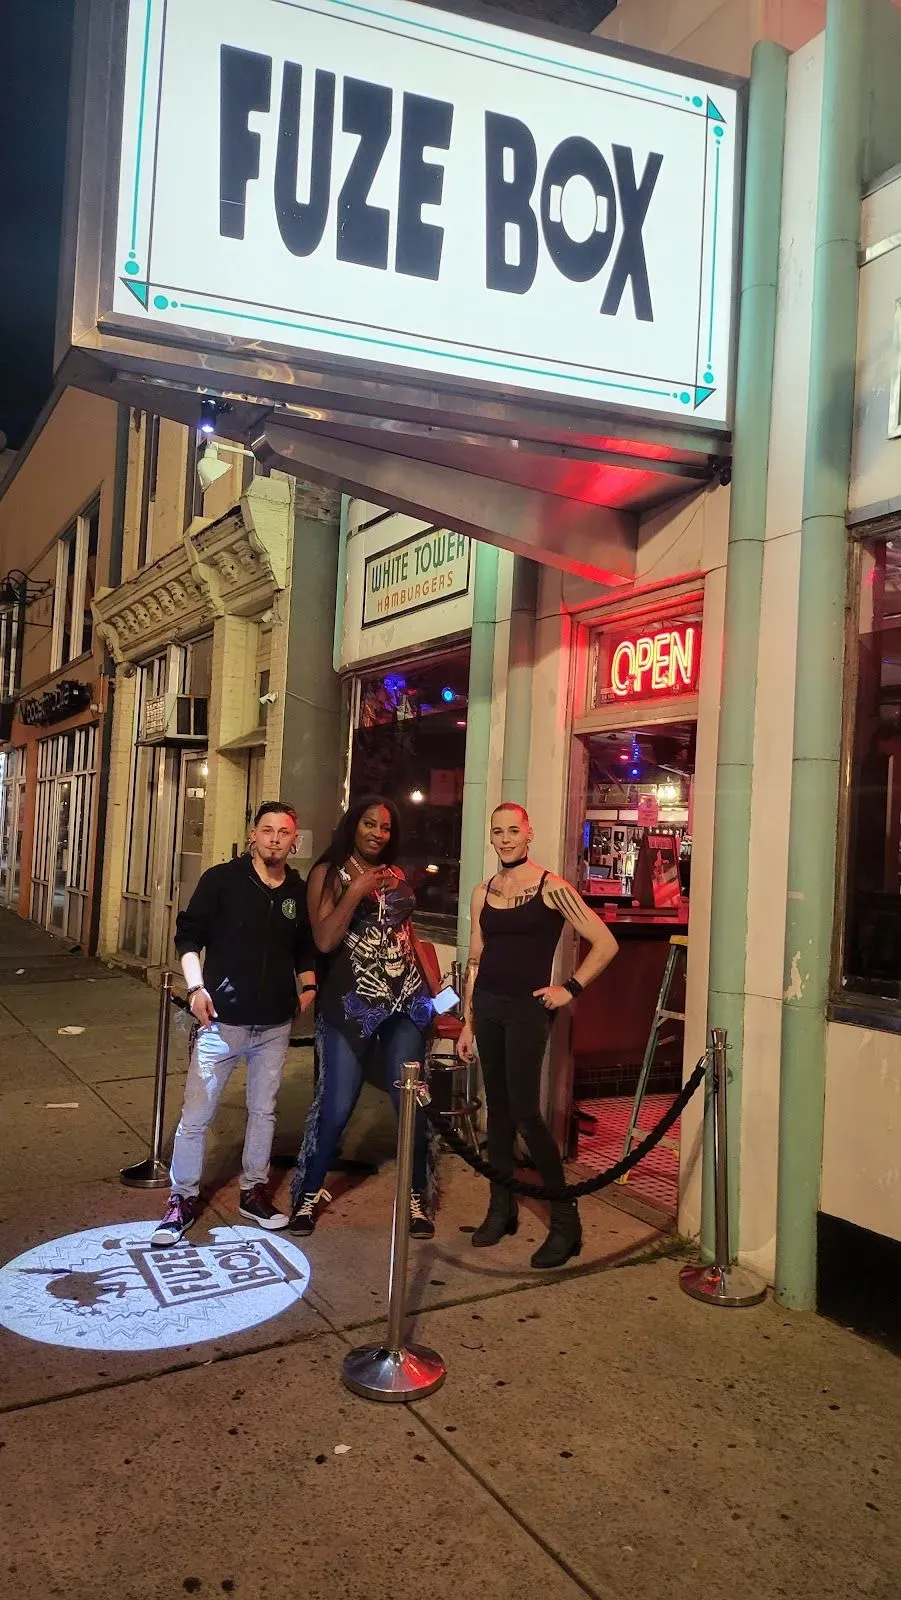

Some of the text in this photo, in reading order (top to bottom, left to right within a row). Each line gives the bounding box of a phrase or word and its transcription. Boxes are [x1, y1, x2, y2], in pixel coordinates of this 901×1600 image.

[219, 43, 664, 323] FUZE BOX
[371, 532, 466, 594] WHITE TOWER
[377, 570, 454, 613] HAMBURGERS
[611, 627, 695, 696] OPEN
[151, 1248, 221, 1297] FUZE
[208, 1243, 277, 1285] BOX
